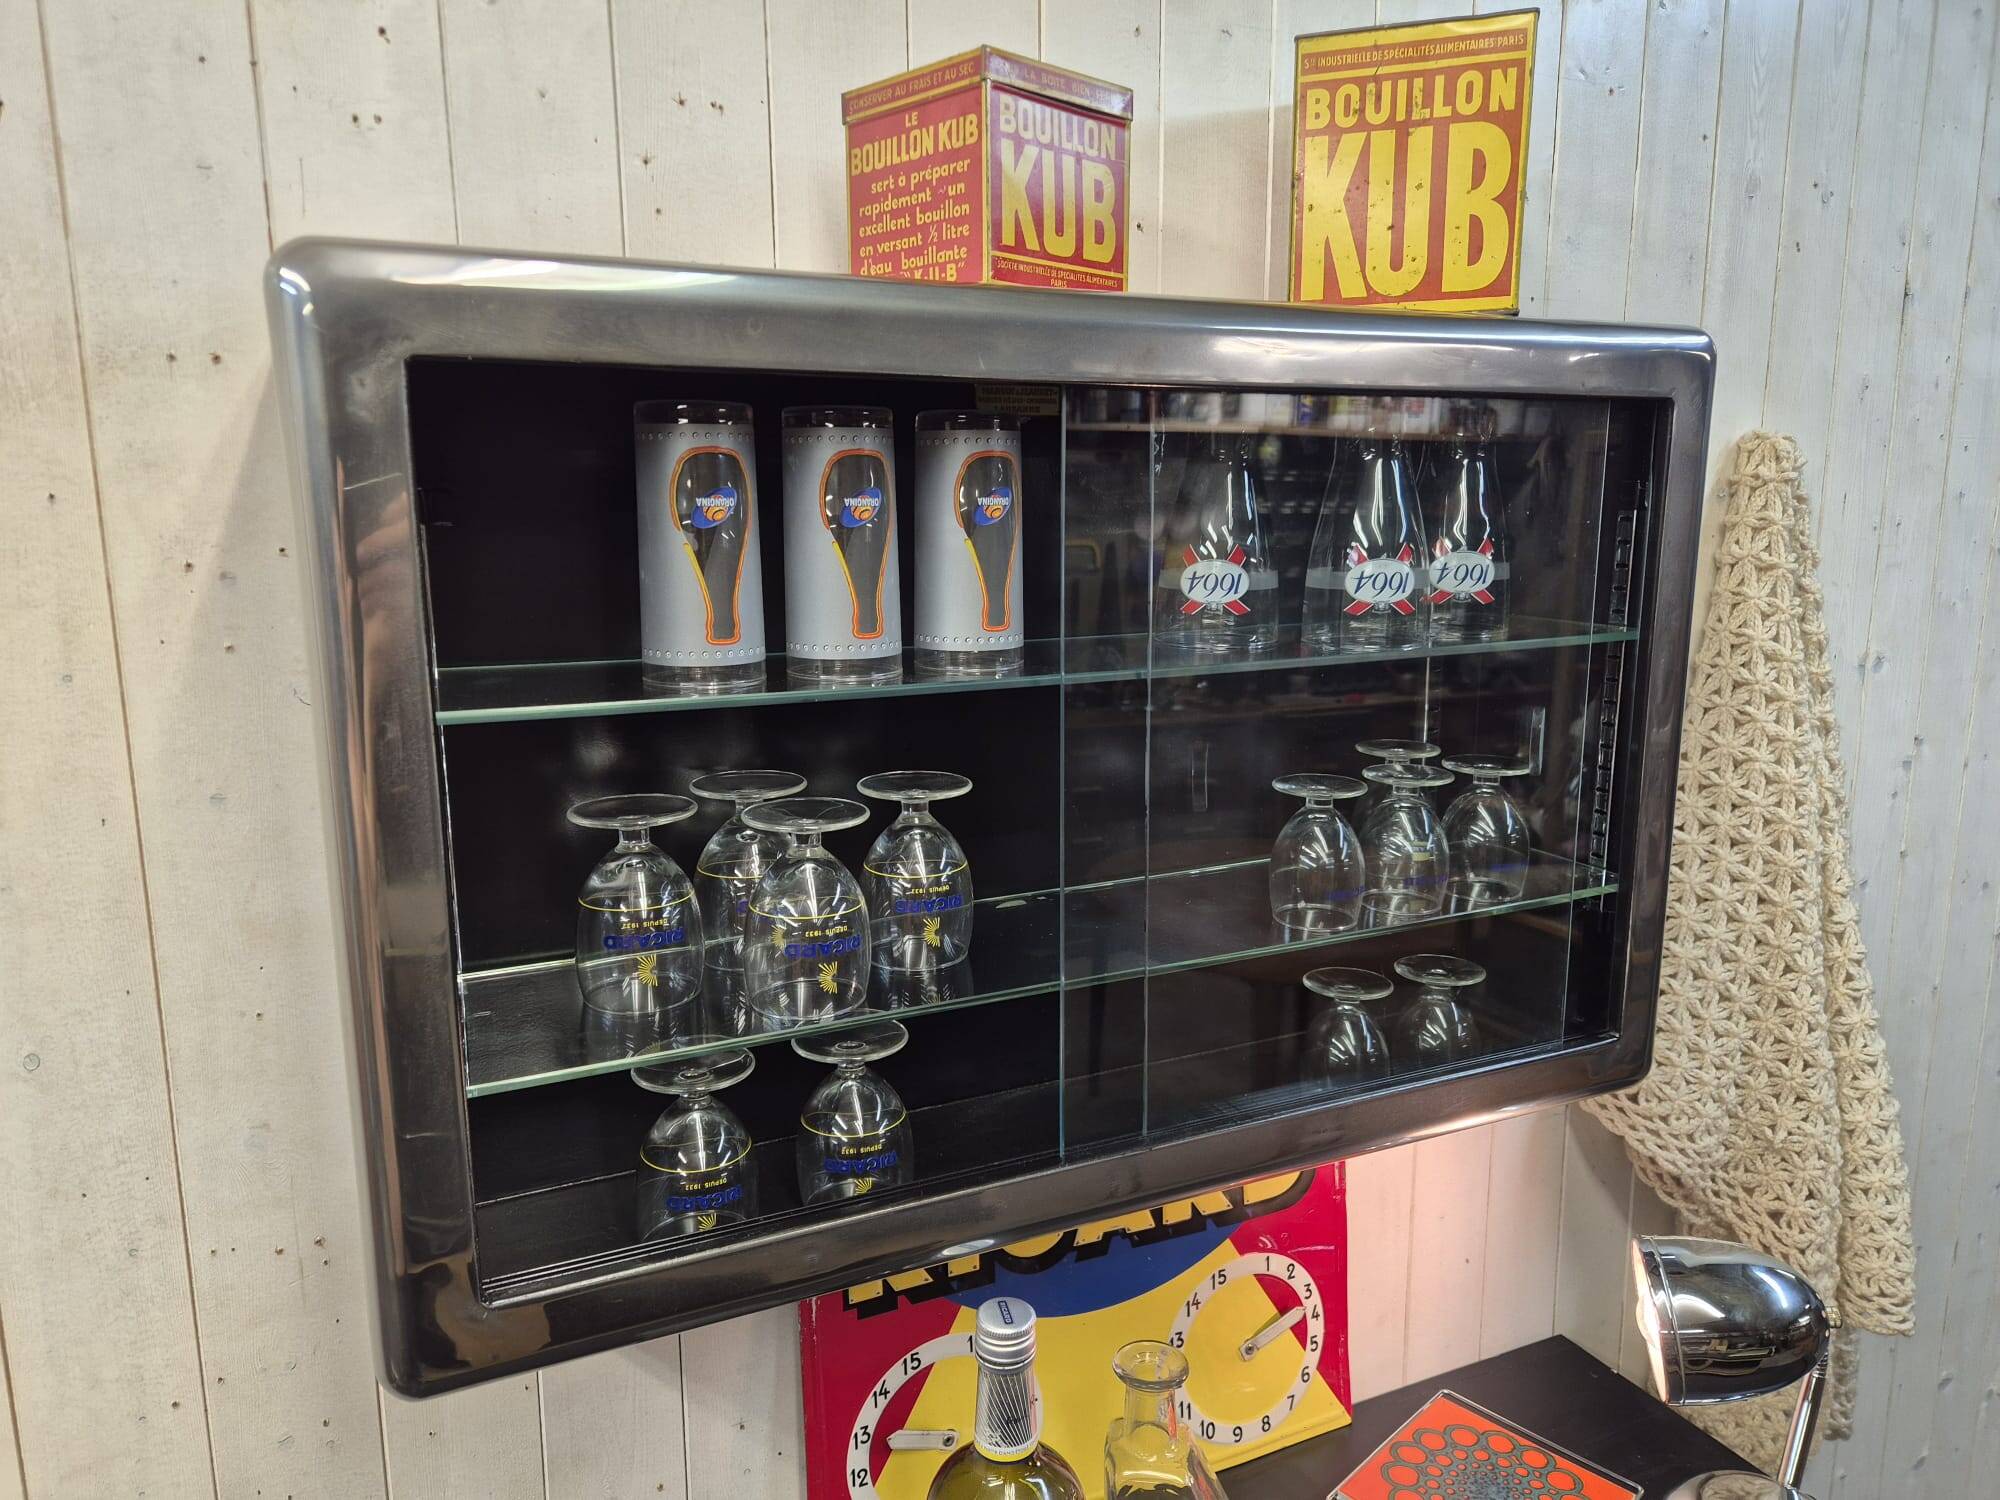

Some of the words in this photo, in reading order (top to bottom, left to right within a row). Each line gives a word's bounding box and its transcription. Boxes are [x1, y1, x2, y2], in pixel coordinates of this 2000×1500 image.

[1317, 51, 1373, 67] INDUSTRIELLE
[1372, 49, 1383, 62] DE
[1383, 43, 1435, 60] SPÉCIALITÉS
[1435, 36, 1494, 56] ALIMENTAIRES
[1497, 33, 1524, 48] PARIS
[895, 83, 906, 98] AU
[909, 78, 931, 93] FRAIS
[933, 71, 942, 85] ET
[944, 67, 957, 81] AU
[959, 61, 975, 77] SEC
[1306, 67, 1518, 130] BOUILLON
[905, 112, 918, 128] LE
[1001, 95, 1116, 161] BOUILLON
[851, 125, 934, 176] BOUILLON
[938, 113, 979, 152] KUB
[871, 174, 895, 194] sert
[898, 171, 906, 187] à
[910, 158, 971, 191] préparer
[859, 187, 932, 221] rapidement
[948, 182, 965, 197] un
[1000, 137, 1116, 264] KUB
[859, 213, 911, 238] excellent
[916, 199, 970, 226] bouillon
[1300, 121, 1512, 301] KUB
[860, 245, 874, 258] en
[877, 232, 922, 254] versant
[942, 222, 970, 240] litre
[860, 258, 892, 276] d'eau
[901, 244, 968, 270] bouillante
[1018, 262, 1050, 276] INDUSTRIELLE
[1050, 269, 1057, 278] DE
[1051, 279, 1067, 288] PARIS
[696, 497, 735, 508] ORANGINA
[844, 497, 880, 508] ORANGINA
[977, 496, 1010, 507] ORANGINA
[1354, 571, 1410, 595] 1664
[1435, 562, 1489, 584] 1664
[1187, 573, 1242, 595] 1664
[928, 885, 950, 894] DEPUIS
[642, 918, 668, 928] DEPUIS
[825, 925, 848, 935] DEPUIS
[860, 1143, 882, 1154] DEPUIS
[704, 1177, 727, 1189] DEPUIS
[1265, 1256, 1270, 1272] 1
[1286, 1263, 1296, 1280] 2
[1210, 1269, 1227, 1290] 15
[1303, 1284, 1313, 1300] 3
[999, 1301, 1013, 1325] RICARD
[1186, 1292, 1201, 1317] 14
[1311, 1305, 1320, 1321] 4
[967, 1335, 974, 1353] 1
[1309, 1335, 1319, 1352] 5
[901, 1352, 922, 1376] 15
[1301, 1366, 1310, 1383] 6
[872, 1379, 890, 1408] 14
[1287, 1395, 1296, 1411] 7
[1178, 1401, 1192, 1420] 11
[1199, 1420, 1216, 1440] 10
[1261, 1415, 1271, 1432] 8
[853, 1425, 871, 1450] 13
[1232, 1426, 1243, 1442] 9
[850, 1468, 869, 1488] 12
